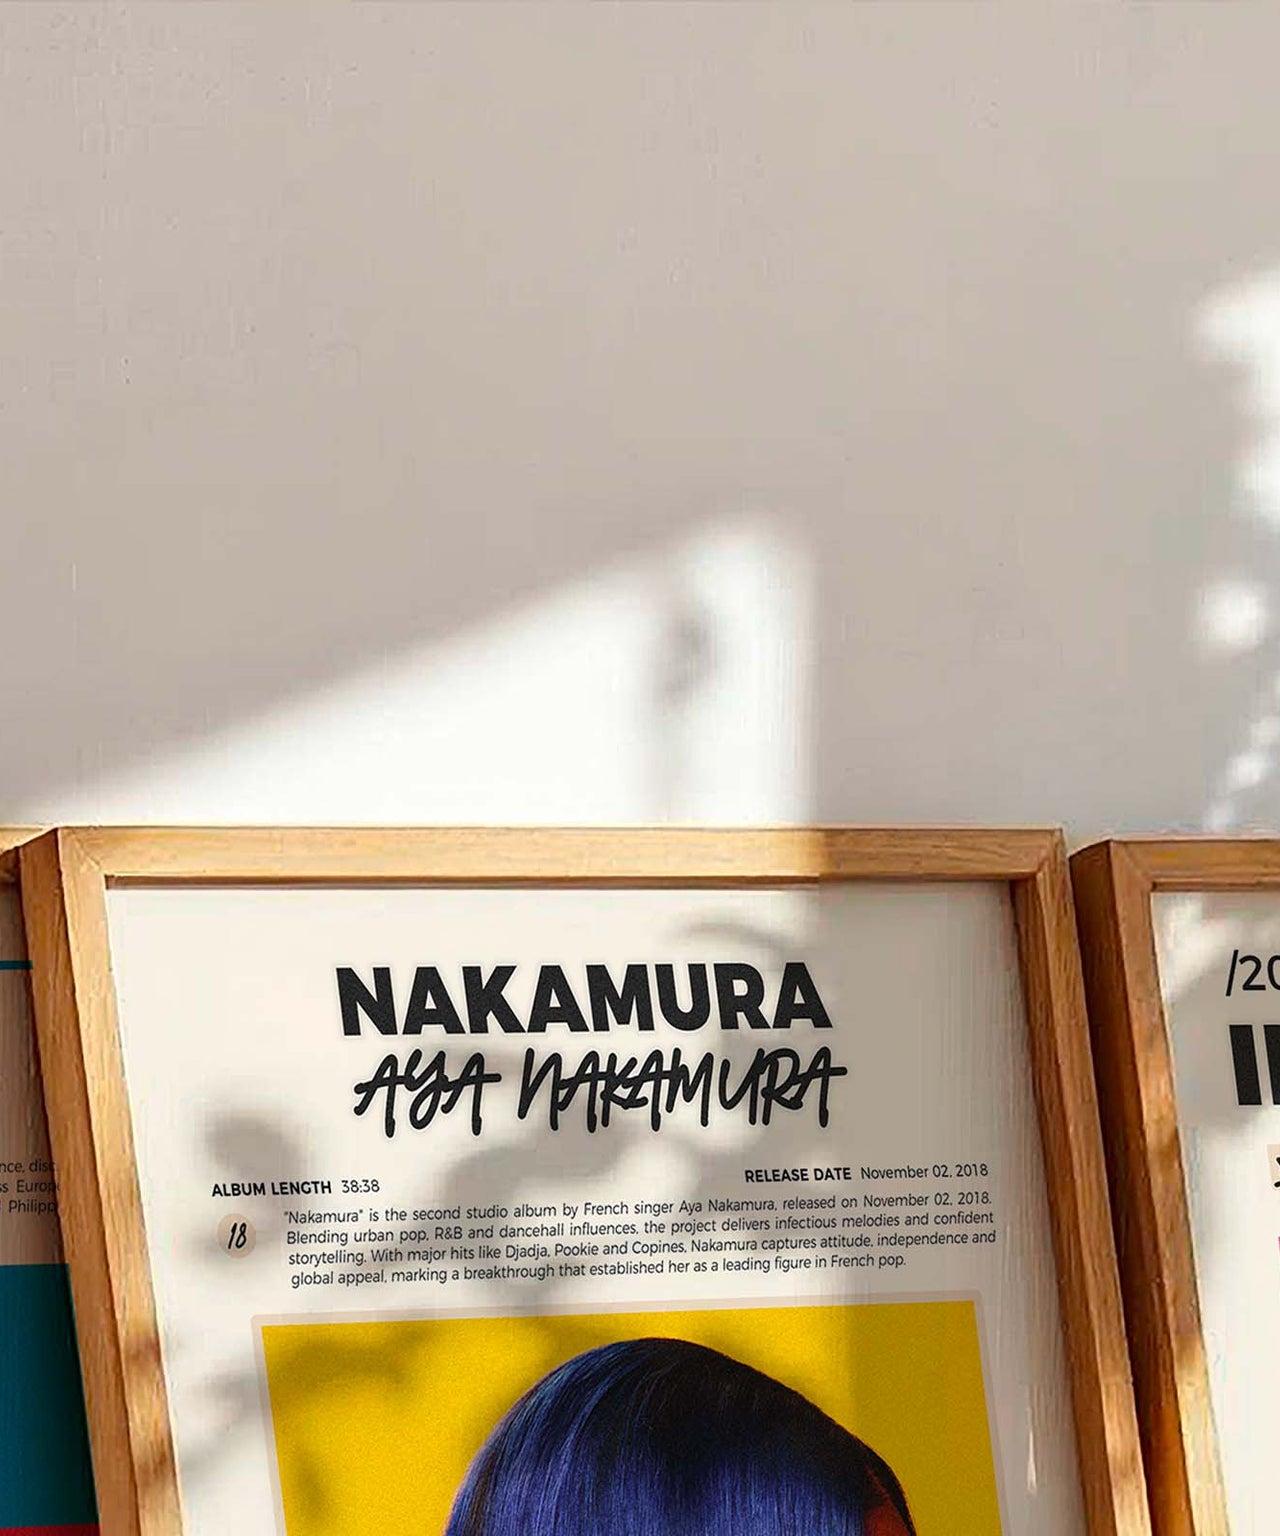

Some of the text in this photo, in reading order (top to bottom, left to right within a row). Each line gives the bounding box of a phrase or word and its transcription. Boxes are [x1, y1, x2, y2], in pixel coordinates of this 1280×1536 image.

[334, 962, 833, 1037] NAKAMURA
[352, 1046, 848, 1138] AYA NAKAMURA
[211, 1178, 381, 1198] ALBUM LENGTH 38:38
[744, 1167, 810, 1183] RELEASE
[813, 1166, 852, 1182] DATE
[860, 1164, 929, 1180] November
[955, 1163, 989, 1178] 2018
[227, 1222, 248, 1249] 18
[290, 1269, 335, 1290] global
[390, 1266, 449, 1286] marking
[450, 1268, 461, 1282] a
[463, 1262, 556, 1282] breakthrough
[558, 1262, 587, 1278] that
[588, 1258, 665, 1277] established
[667, 1259, 691, 1274] her
[692, 1260, 709, 1273] as
[709, 1260, 720, 1273] a
[722, 1256, 772, 1275] leading
[773, 1254, 813, 1274] figure
[814, 1253, 828, 1269] in
[830, 1252, 876, 1269] French
[877, 1254, 907, 1270] pop.
